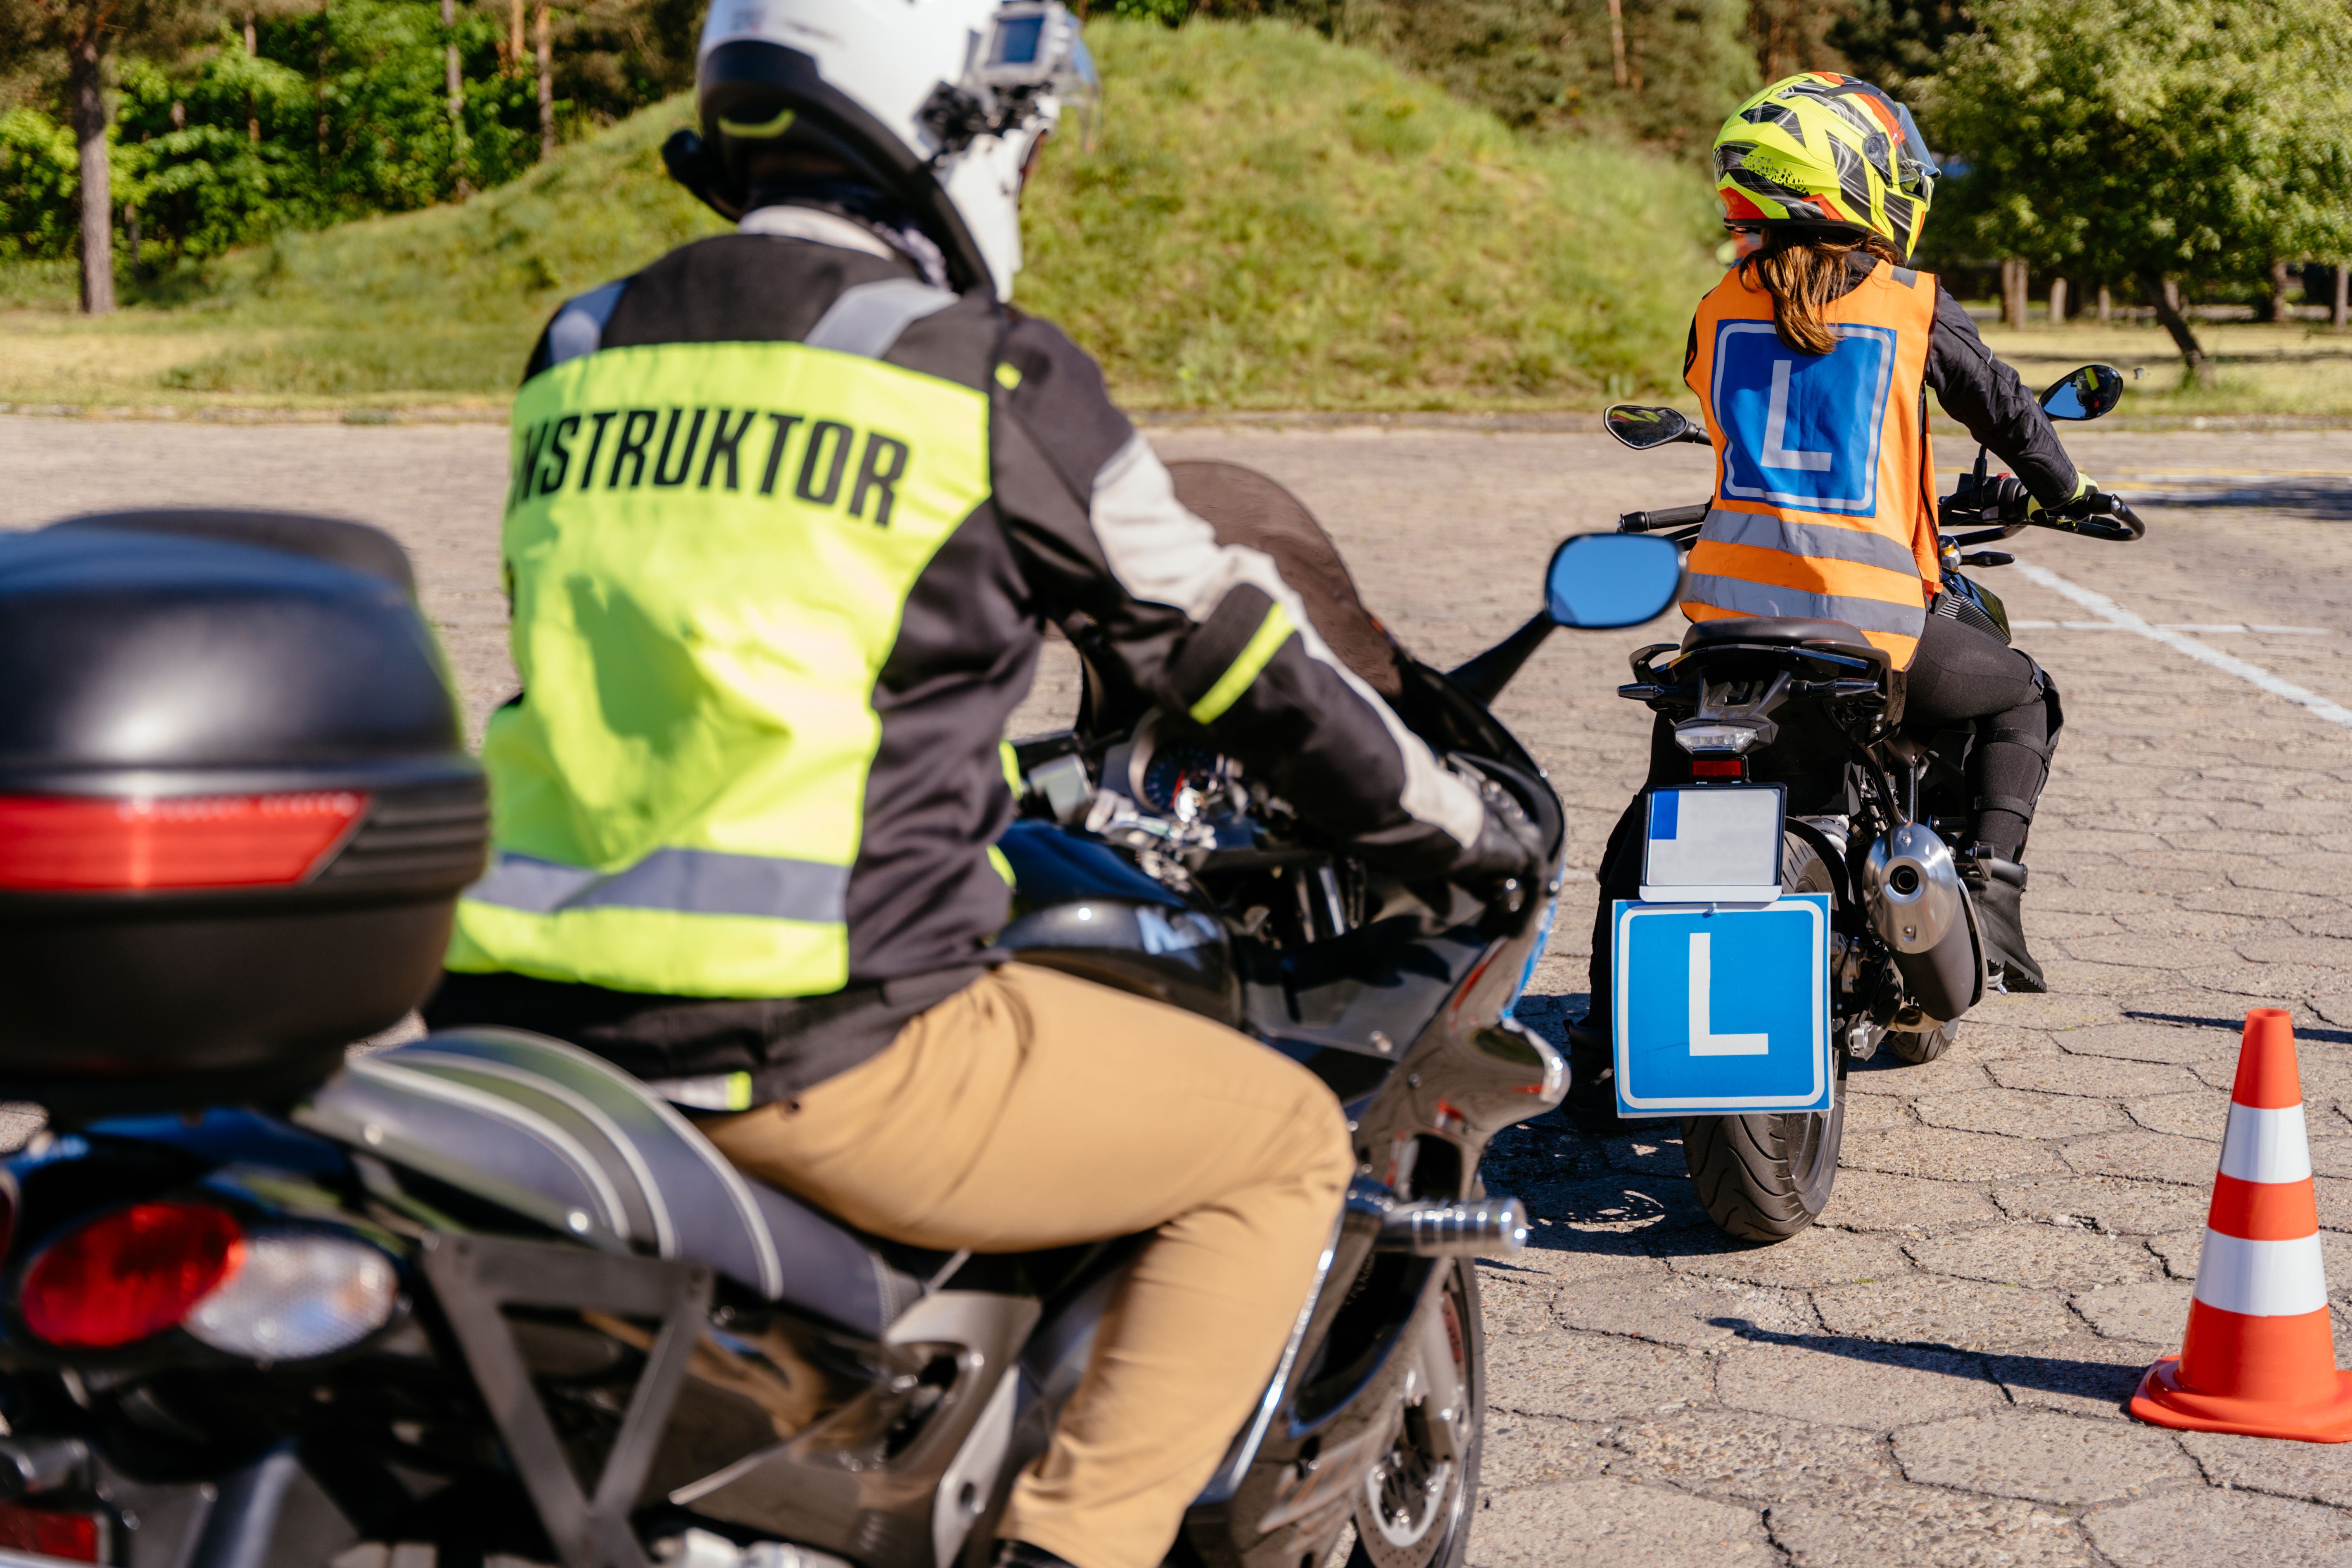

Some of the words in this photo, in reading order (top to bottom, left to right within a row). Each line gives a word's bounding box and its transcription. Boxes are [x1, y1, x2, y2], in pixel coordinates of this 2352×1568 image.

[509, 408, 911, 529] NSTRUKTOR
[1761, 360, 1832, 472] L
[1689, 932, 1768, 1056] L
